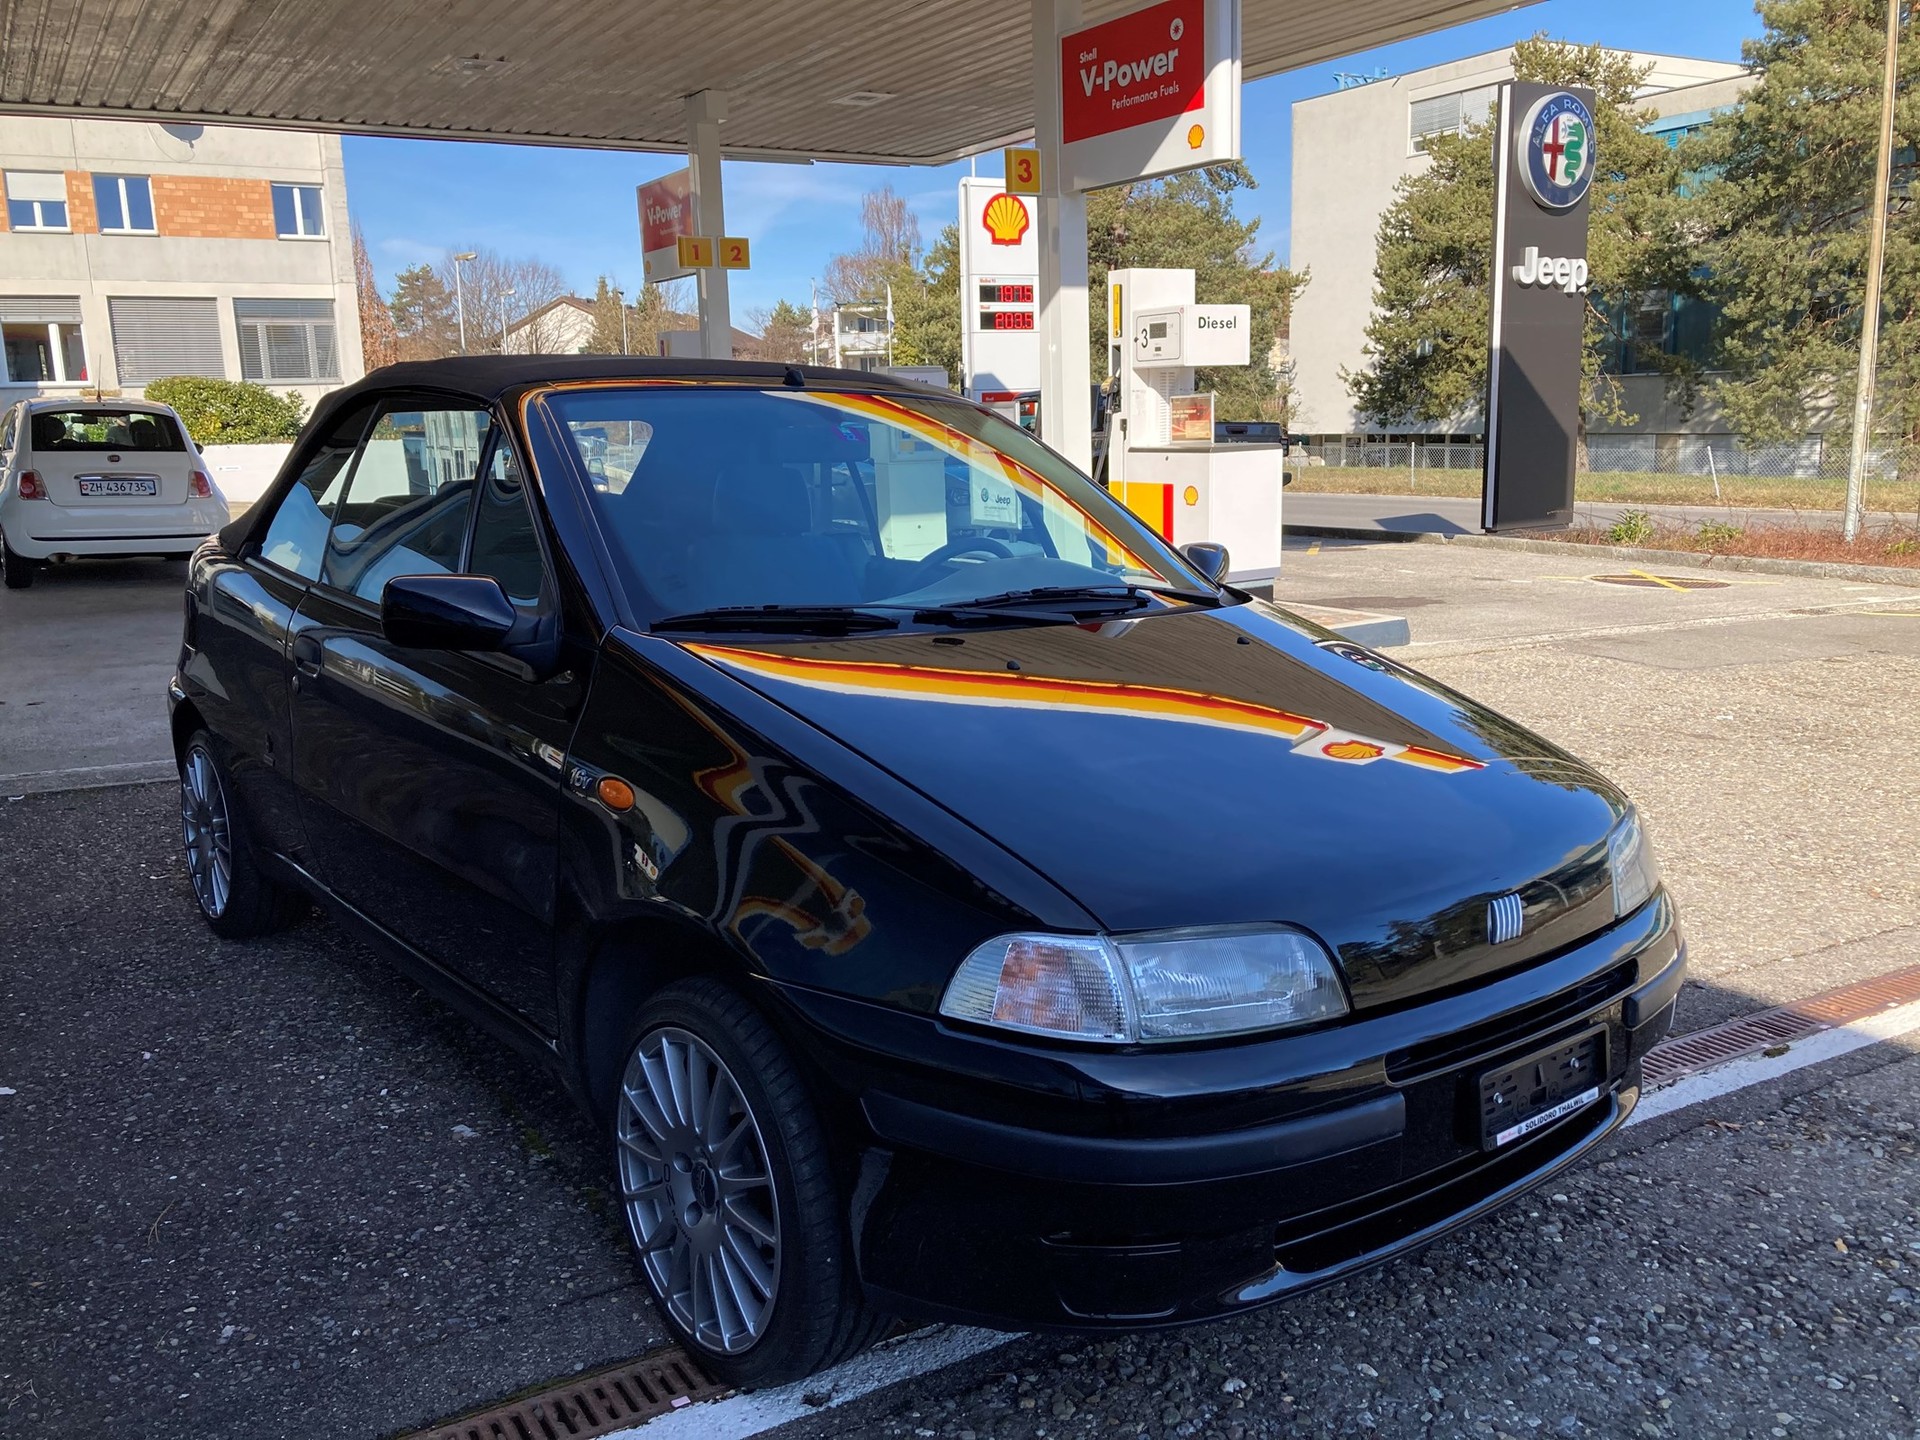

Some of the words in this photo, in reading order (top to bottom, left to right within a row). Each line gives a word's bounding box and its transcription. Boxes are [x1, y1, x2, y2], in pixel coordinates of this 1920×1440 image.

[1080, 47, 1098, 64] Shell
[1080, 48, 1179, 97] V-Power
[1111, 91, 1159, 110] Performance
[1160, 80, 1180, 97] Fuels
[1533, 104, 1559, 147] ALFA
[1564, 100, 1595, 153] ROMEO
[1017, 158, 1033, 183] 3
[647, 203, 682, 226] V-Power
[692, 244, 700, 261] 1
[730, 245, 742, 262] 2
[1512, 246, 1588, 293] Jeep
[1198, 315, 1237, 329] Diesel
[1141, 328, 1148, 348] 3
[995, 494, 1011, 505] Jeep
[1525, 1109, 1557, 1130] SOLIDORO
[1558, 1096, 1584, 1114] THALWIL
